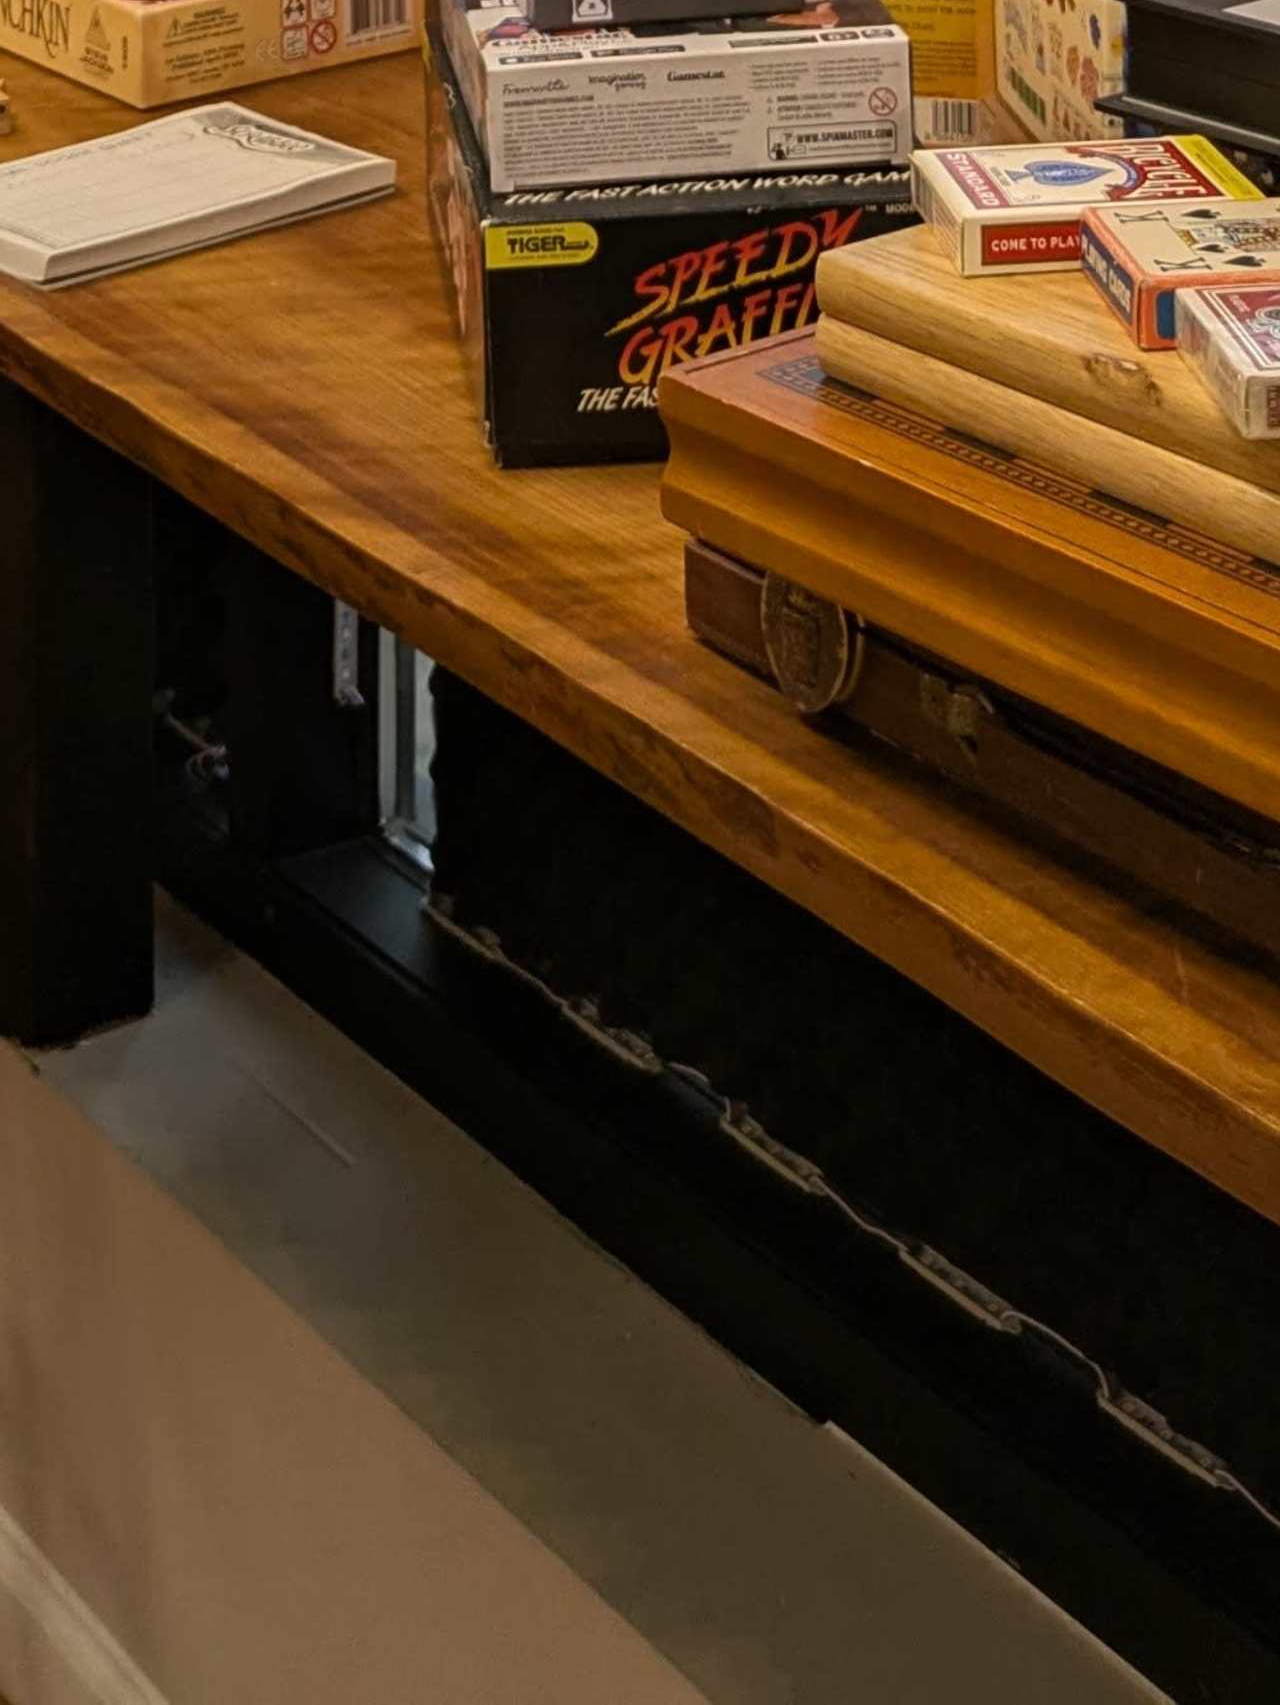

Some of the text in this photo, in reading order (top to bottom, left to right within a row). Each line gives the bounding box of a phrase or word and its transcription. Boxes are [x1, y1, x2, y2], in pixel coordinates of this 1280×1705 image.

[796, 128, 894, 144] WWW.SPINMASTER.COM
[946, 152, 1001, 208] STANDARD
[1110, 142, 1211, 198] BICYCLE
[504, 172, 839, 206] THE FAST ACTION WORD
[506, 236, 567, 254] TIGER
[991, 238, 1028, 252] COME
[1029, 237, 1049, 250] TO
[605, 207, 865, 337] SPEEDY
[577, 388, 619, 412] THE
